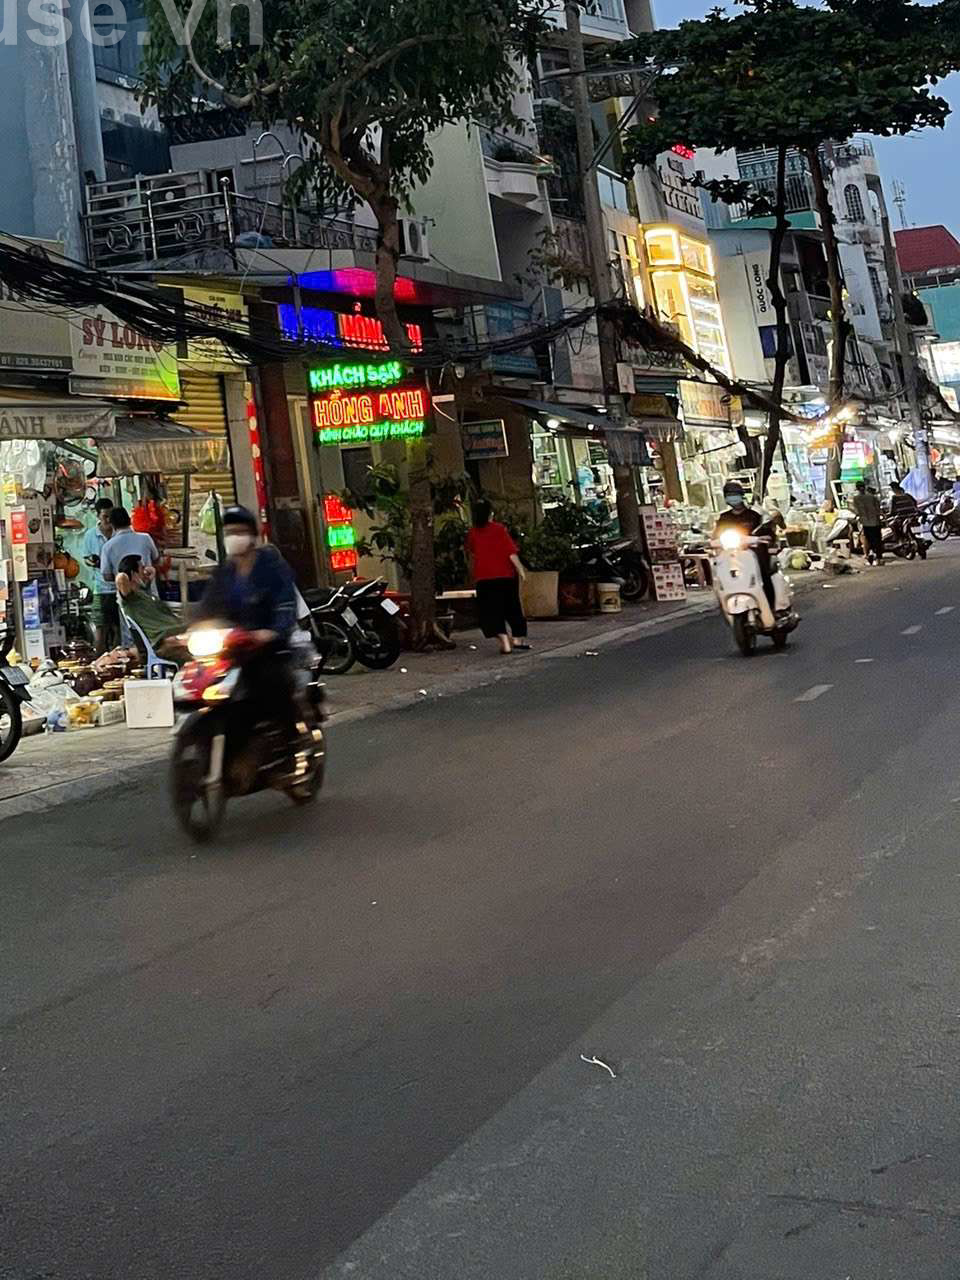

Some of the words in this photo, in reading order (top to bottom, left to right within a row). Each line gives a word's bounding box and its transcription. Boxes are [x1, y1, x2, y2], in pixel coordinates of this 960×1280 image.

[752, 264, 762, 287] LONG
[309, 363, 365, 388] KHÁCH
[379, 390, 425, 420] ANH
